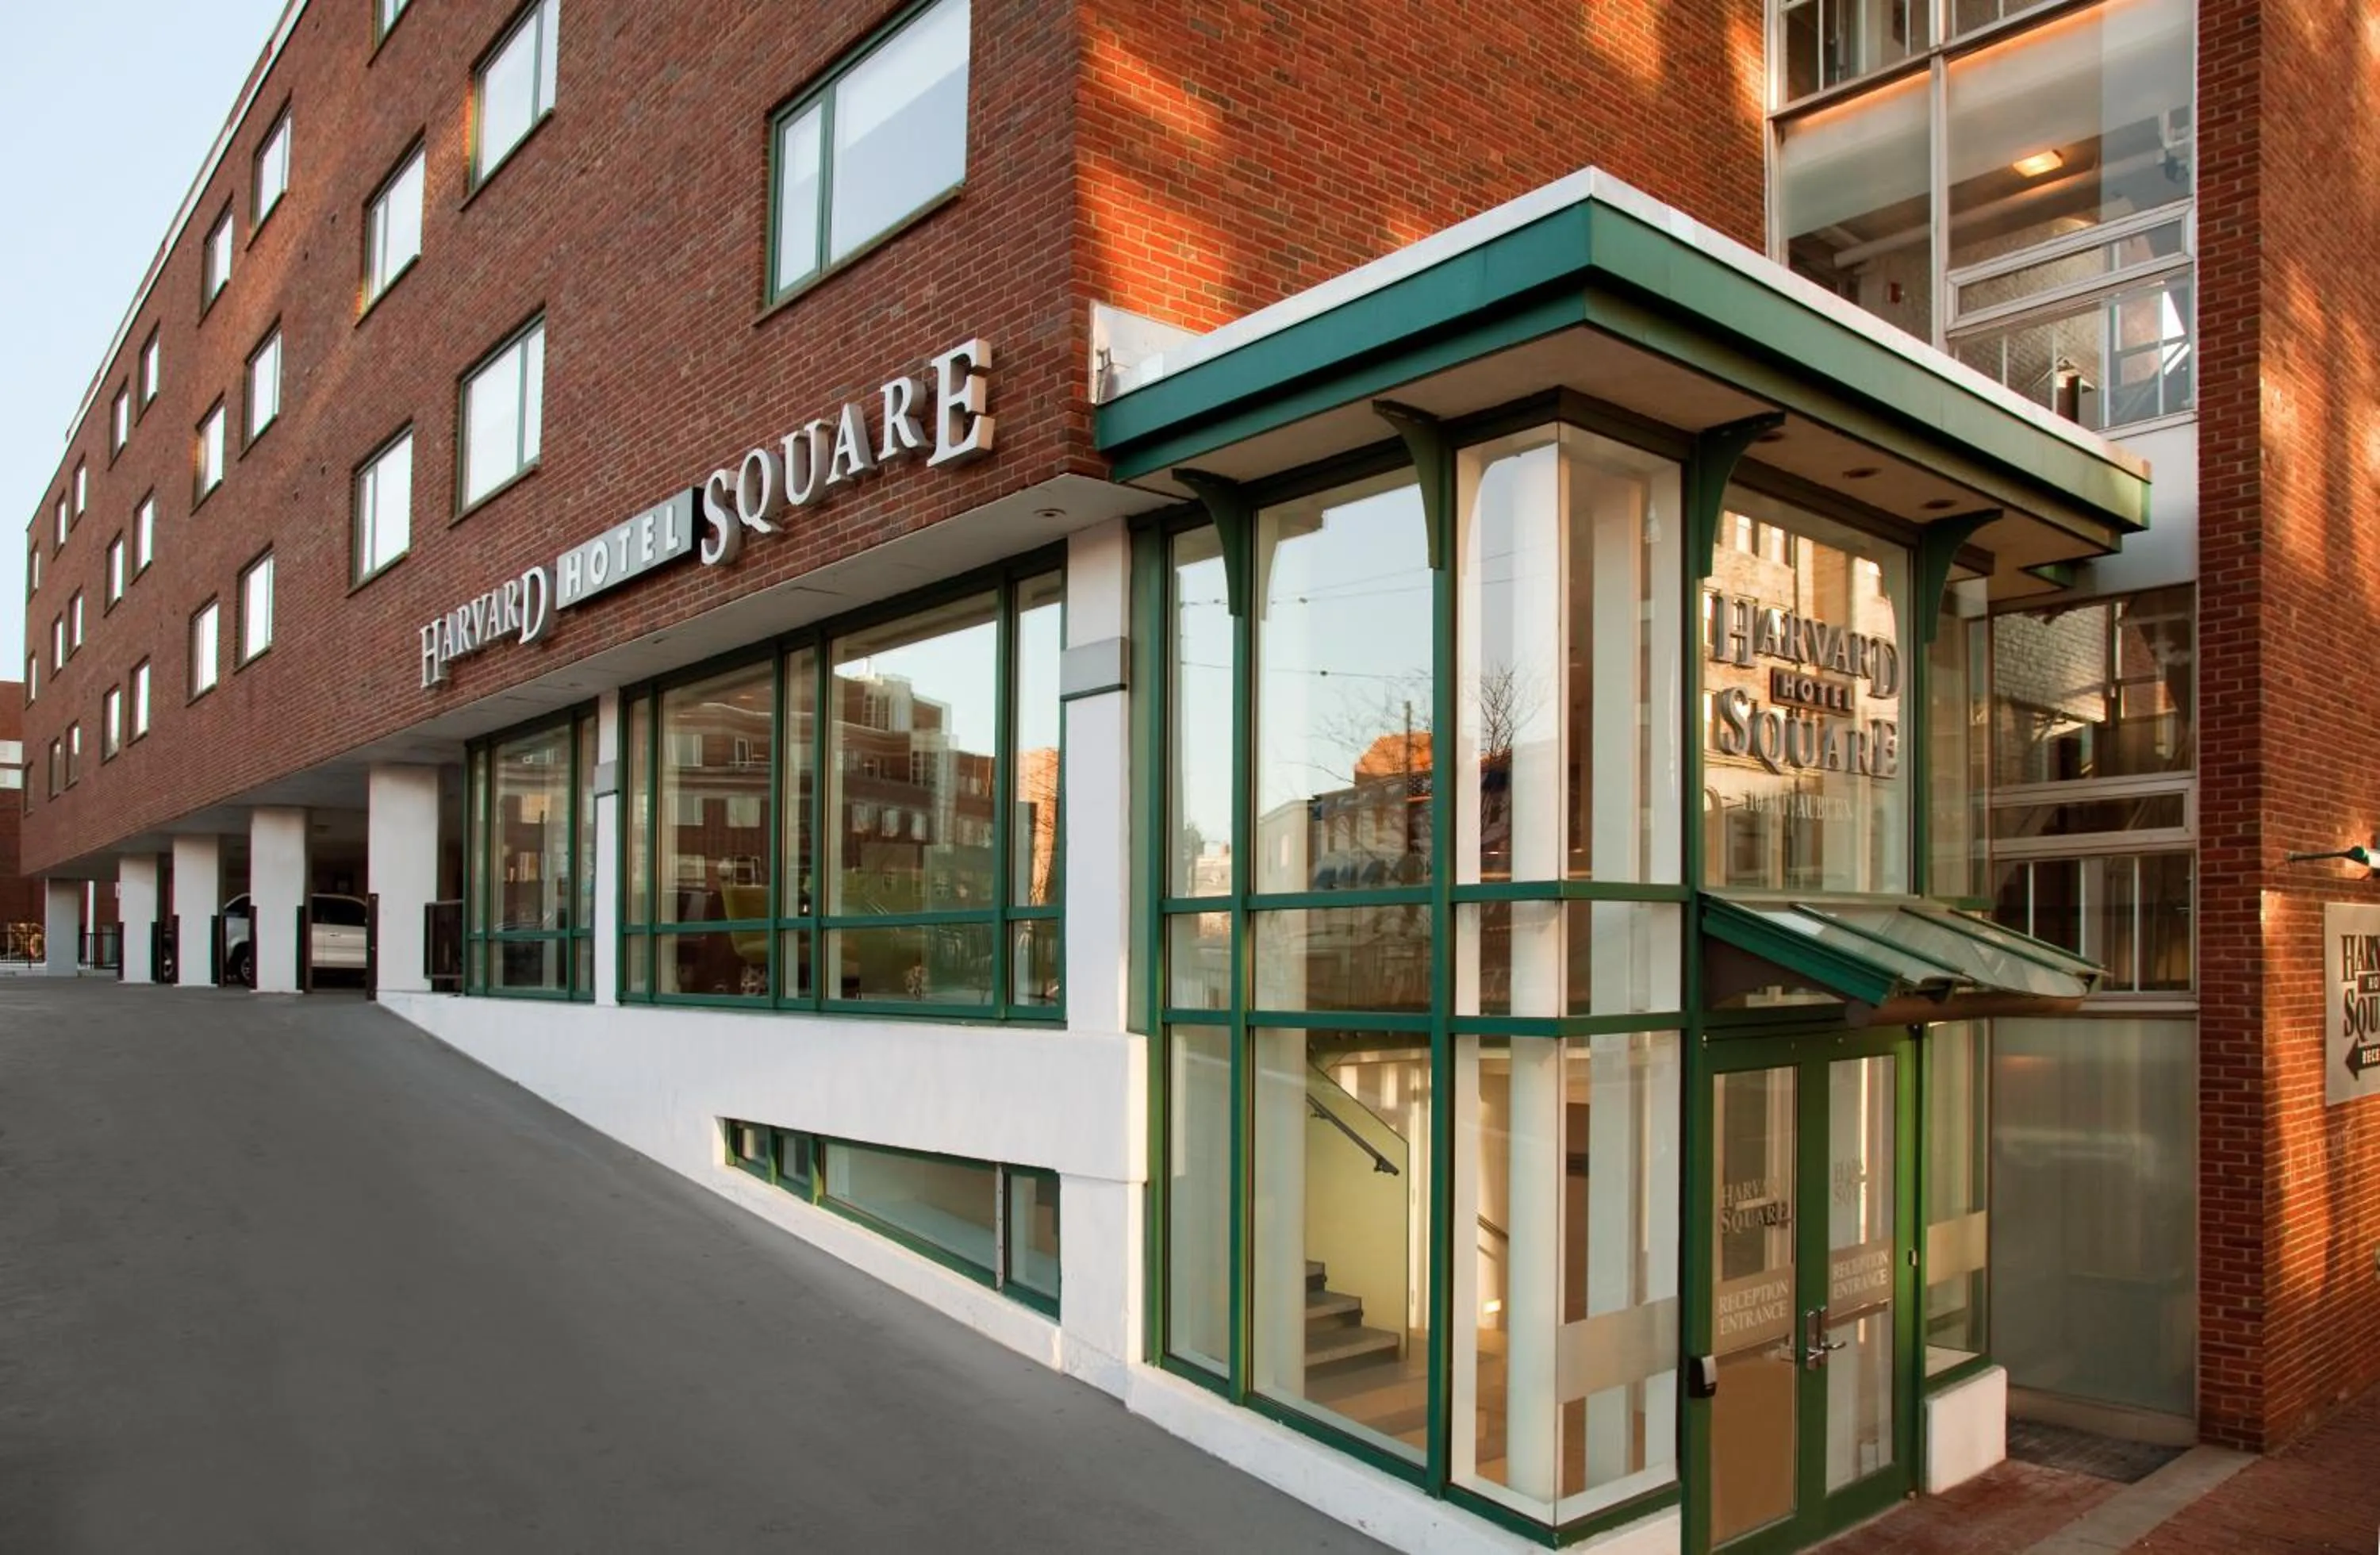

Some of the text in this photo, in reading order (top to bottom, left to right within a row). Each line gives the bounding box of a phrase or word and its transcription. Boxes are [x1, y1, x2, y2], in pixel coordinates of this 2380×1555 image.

[420, 338, 995, 689] HARVARD HOTEL SQUARE
[1709, 594, 1903, 699] HARVARD
[1783, 674, 1855, 712] HOTEL
[1718, 687, 1898, 779] SQUARE
[1720, 1200, 1788, 1234] SQUARE
[1833, 1249, 1890, 1281] RECEPTION
[1718, 1279, 1790, 1313] RECEPTION
[1833, 1269, 1888, 1300] ENTRANCE
[1719, 1300, 1787, 1335] ENTRANCE
